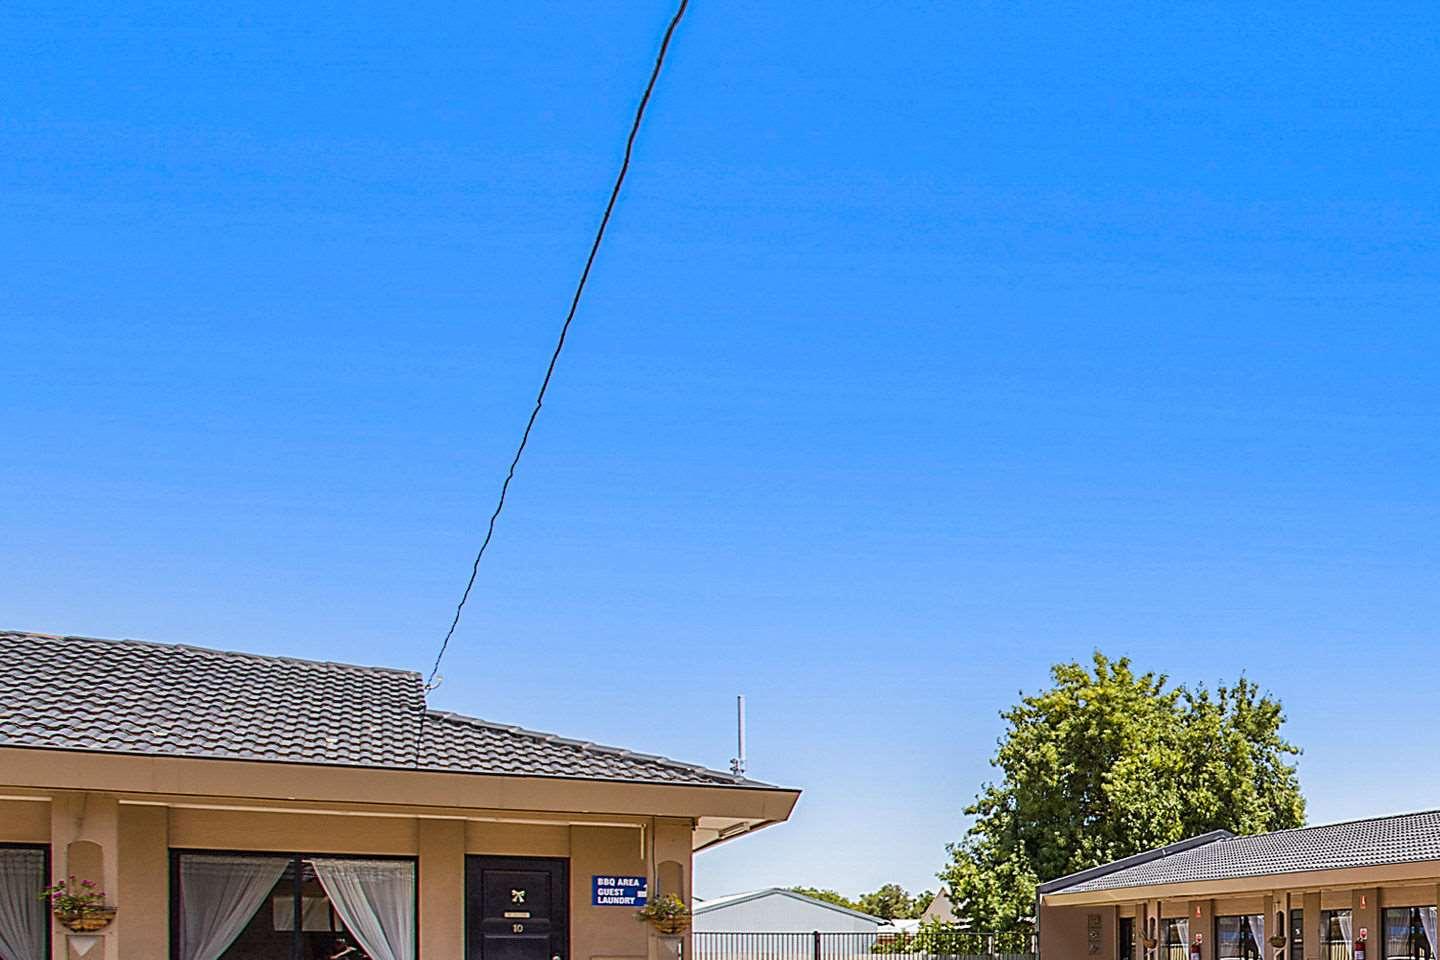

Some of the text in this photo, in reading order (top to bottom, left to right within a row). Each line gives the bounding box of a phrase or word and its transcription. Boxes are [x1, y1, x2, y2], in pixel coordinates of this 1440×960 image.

[597, 877, 640, 887] BBQ AREA
[597, 888, 625, 896] GUEST
[512, 923, 524, 933] 10
